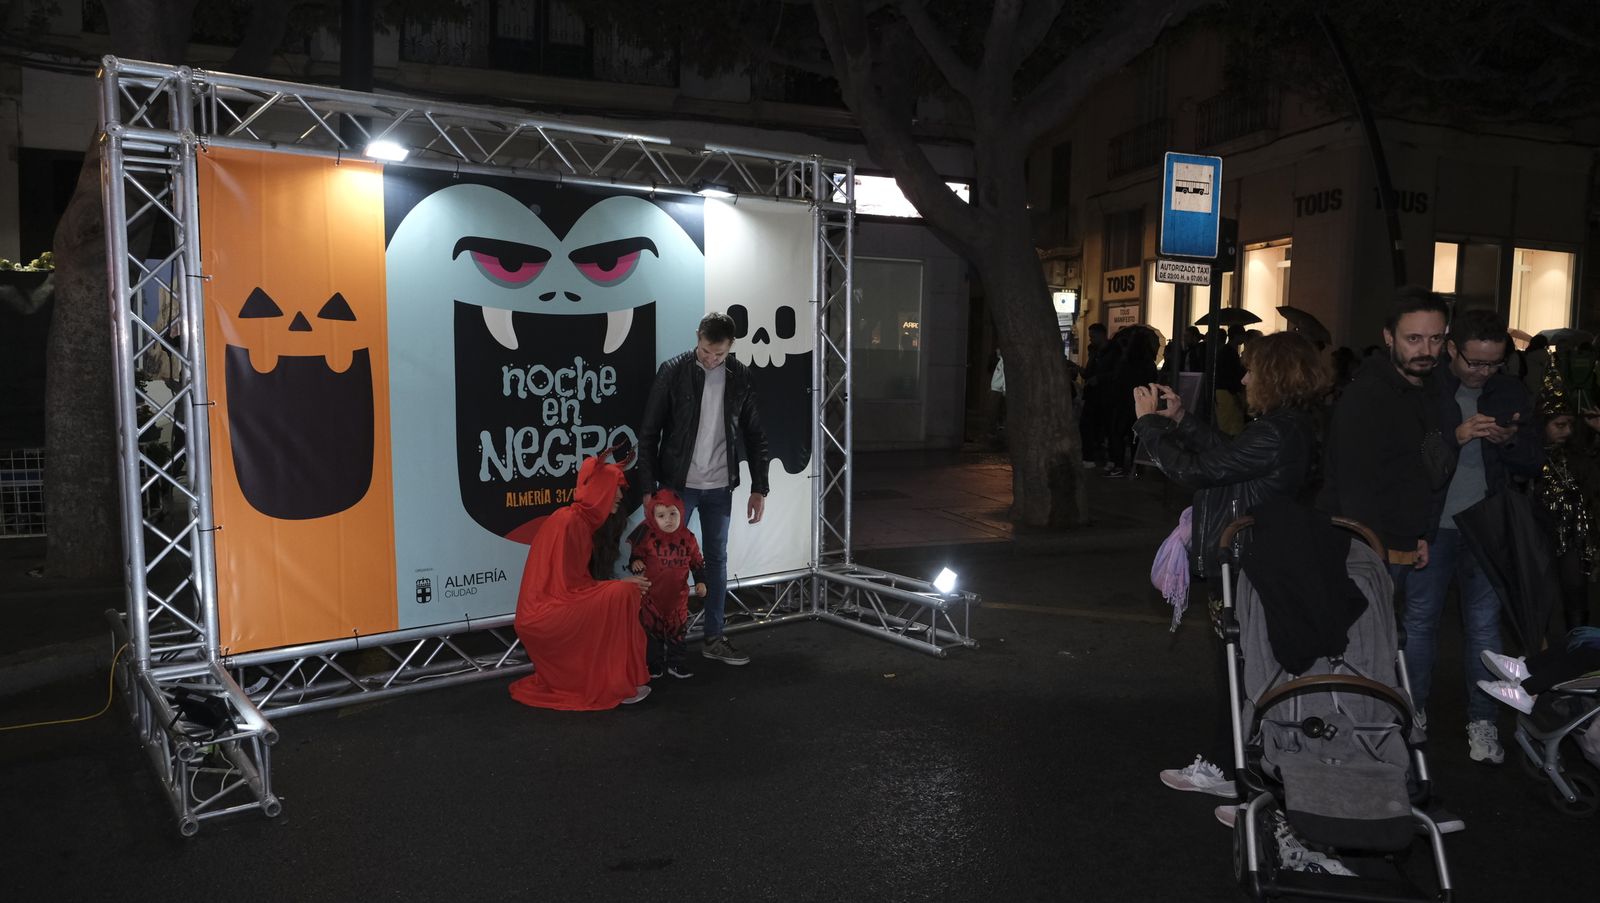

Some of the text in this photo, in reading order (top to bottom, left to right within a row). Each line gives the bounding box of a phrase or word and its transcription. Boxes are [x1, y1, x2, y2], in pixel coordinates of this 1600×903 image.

[1294, 188, 1342, 218] TOUS
[1160, 263, 1210, 275] AUTORIZADO TAXI
[1107, 274, 1135, 293] TOUS
[542, 397, 582, 426] en
[505, 487, 552, 508] ALMERÍA
[444, 567, 507, 588] ALMERÍA
[444, 586, 478, 598] CIUDAD
